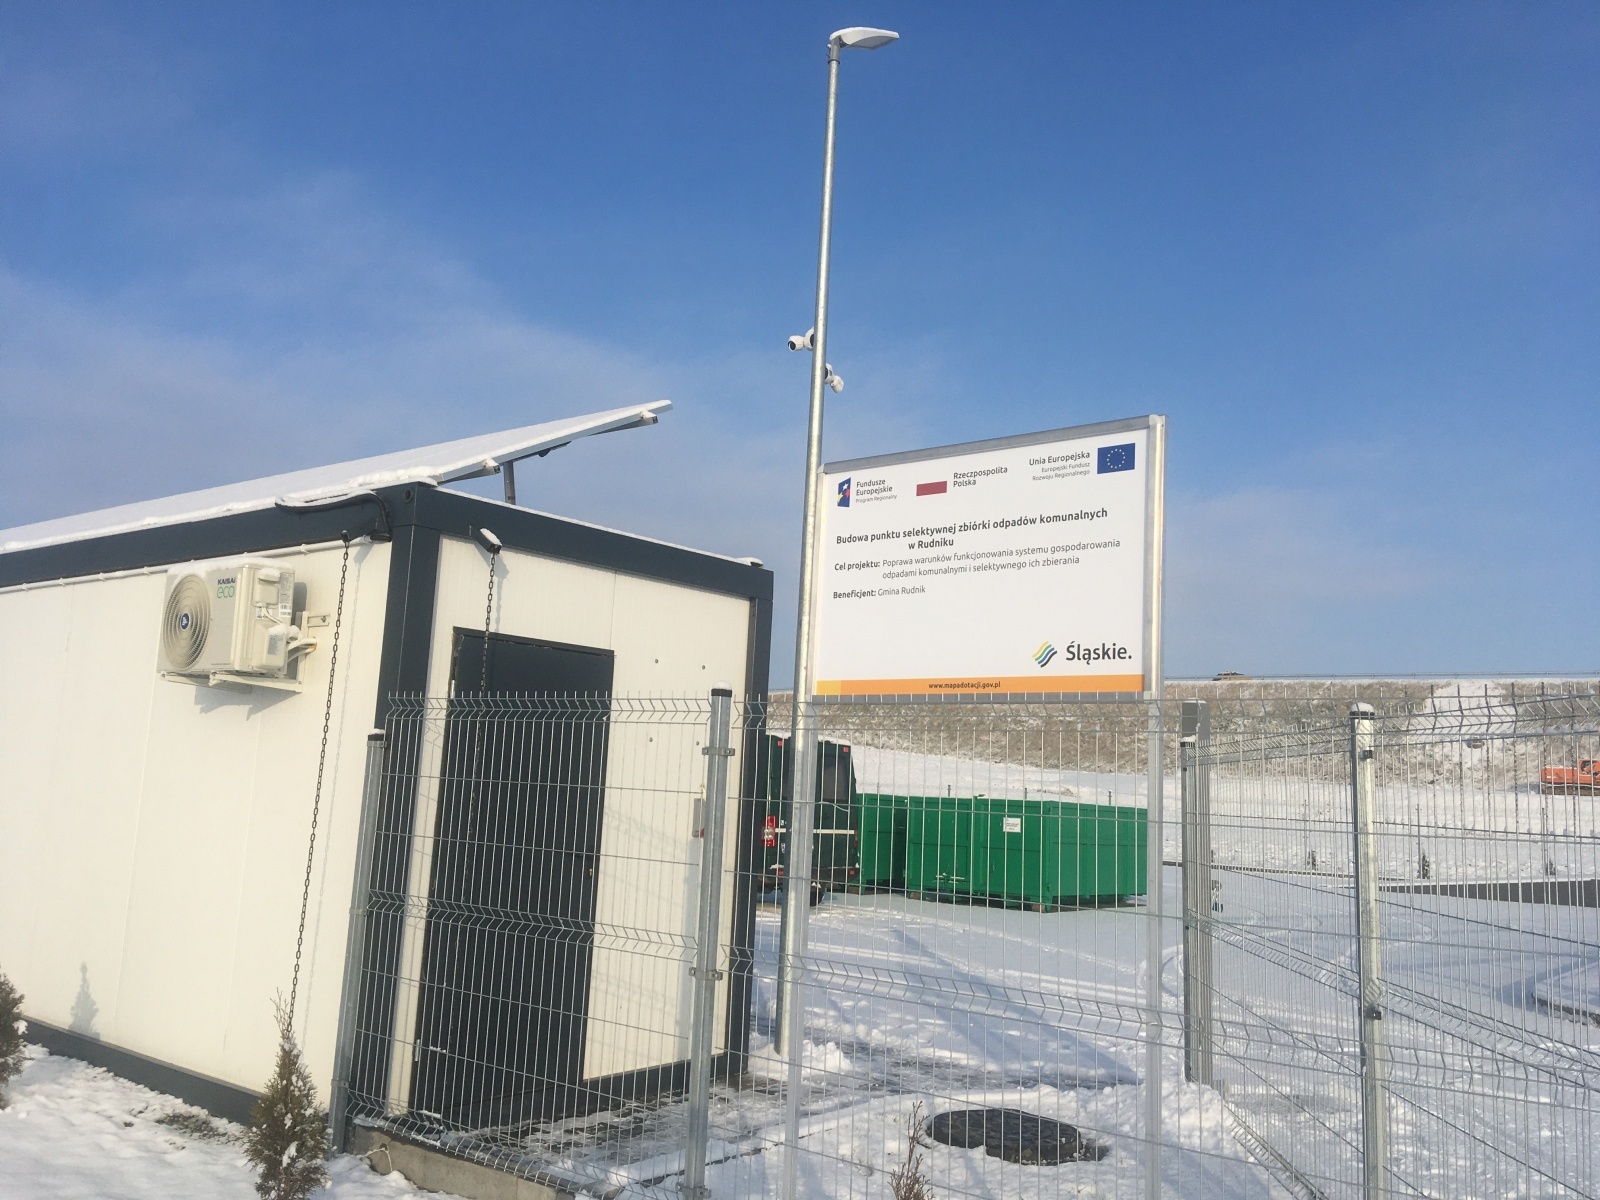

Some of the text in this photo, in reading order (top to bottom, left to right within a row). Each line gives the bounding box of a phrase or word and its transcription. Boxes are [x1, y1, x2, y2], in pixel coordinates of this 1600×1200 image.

[1029, 451, 1090, 465] Unia Europejska
[954, 467, 1008, 479] Rzeczpospolita
[1042, 465, 1067, 473] Europejski
[1055, 470, 1090, 478] Regionalnego
[857, 479, 885, 488] Fundusze
[953, 479, 976, 487] Polska
[856, 486, 892, 496] Europejskie
[836, 508, 1108, 544] Budowa punktu selektywnej zbiórki odpadów komunalnych
[908, 537, 954, 550] w Rudniku
[834, 538, 1120, 571] Cel projektu: Poprawa warunków funkcjonowania systemu gospodarowania
[883, 555, 1079, 580] odpadami komunalnymi i selektywnego ich zbierania
[218, 577, 236, 585] KAISAI
[217, 586, 235, 598] eco
[833, 585, 926, 600] Beneficjent: Gmina Rudnik
[1066, 640, 1132, 665] Śląskie.
[928, 681, 1001, 690] www.mapadotacji.gov.pl
